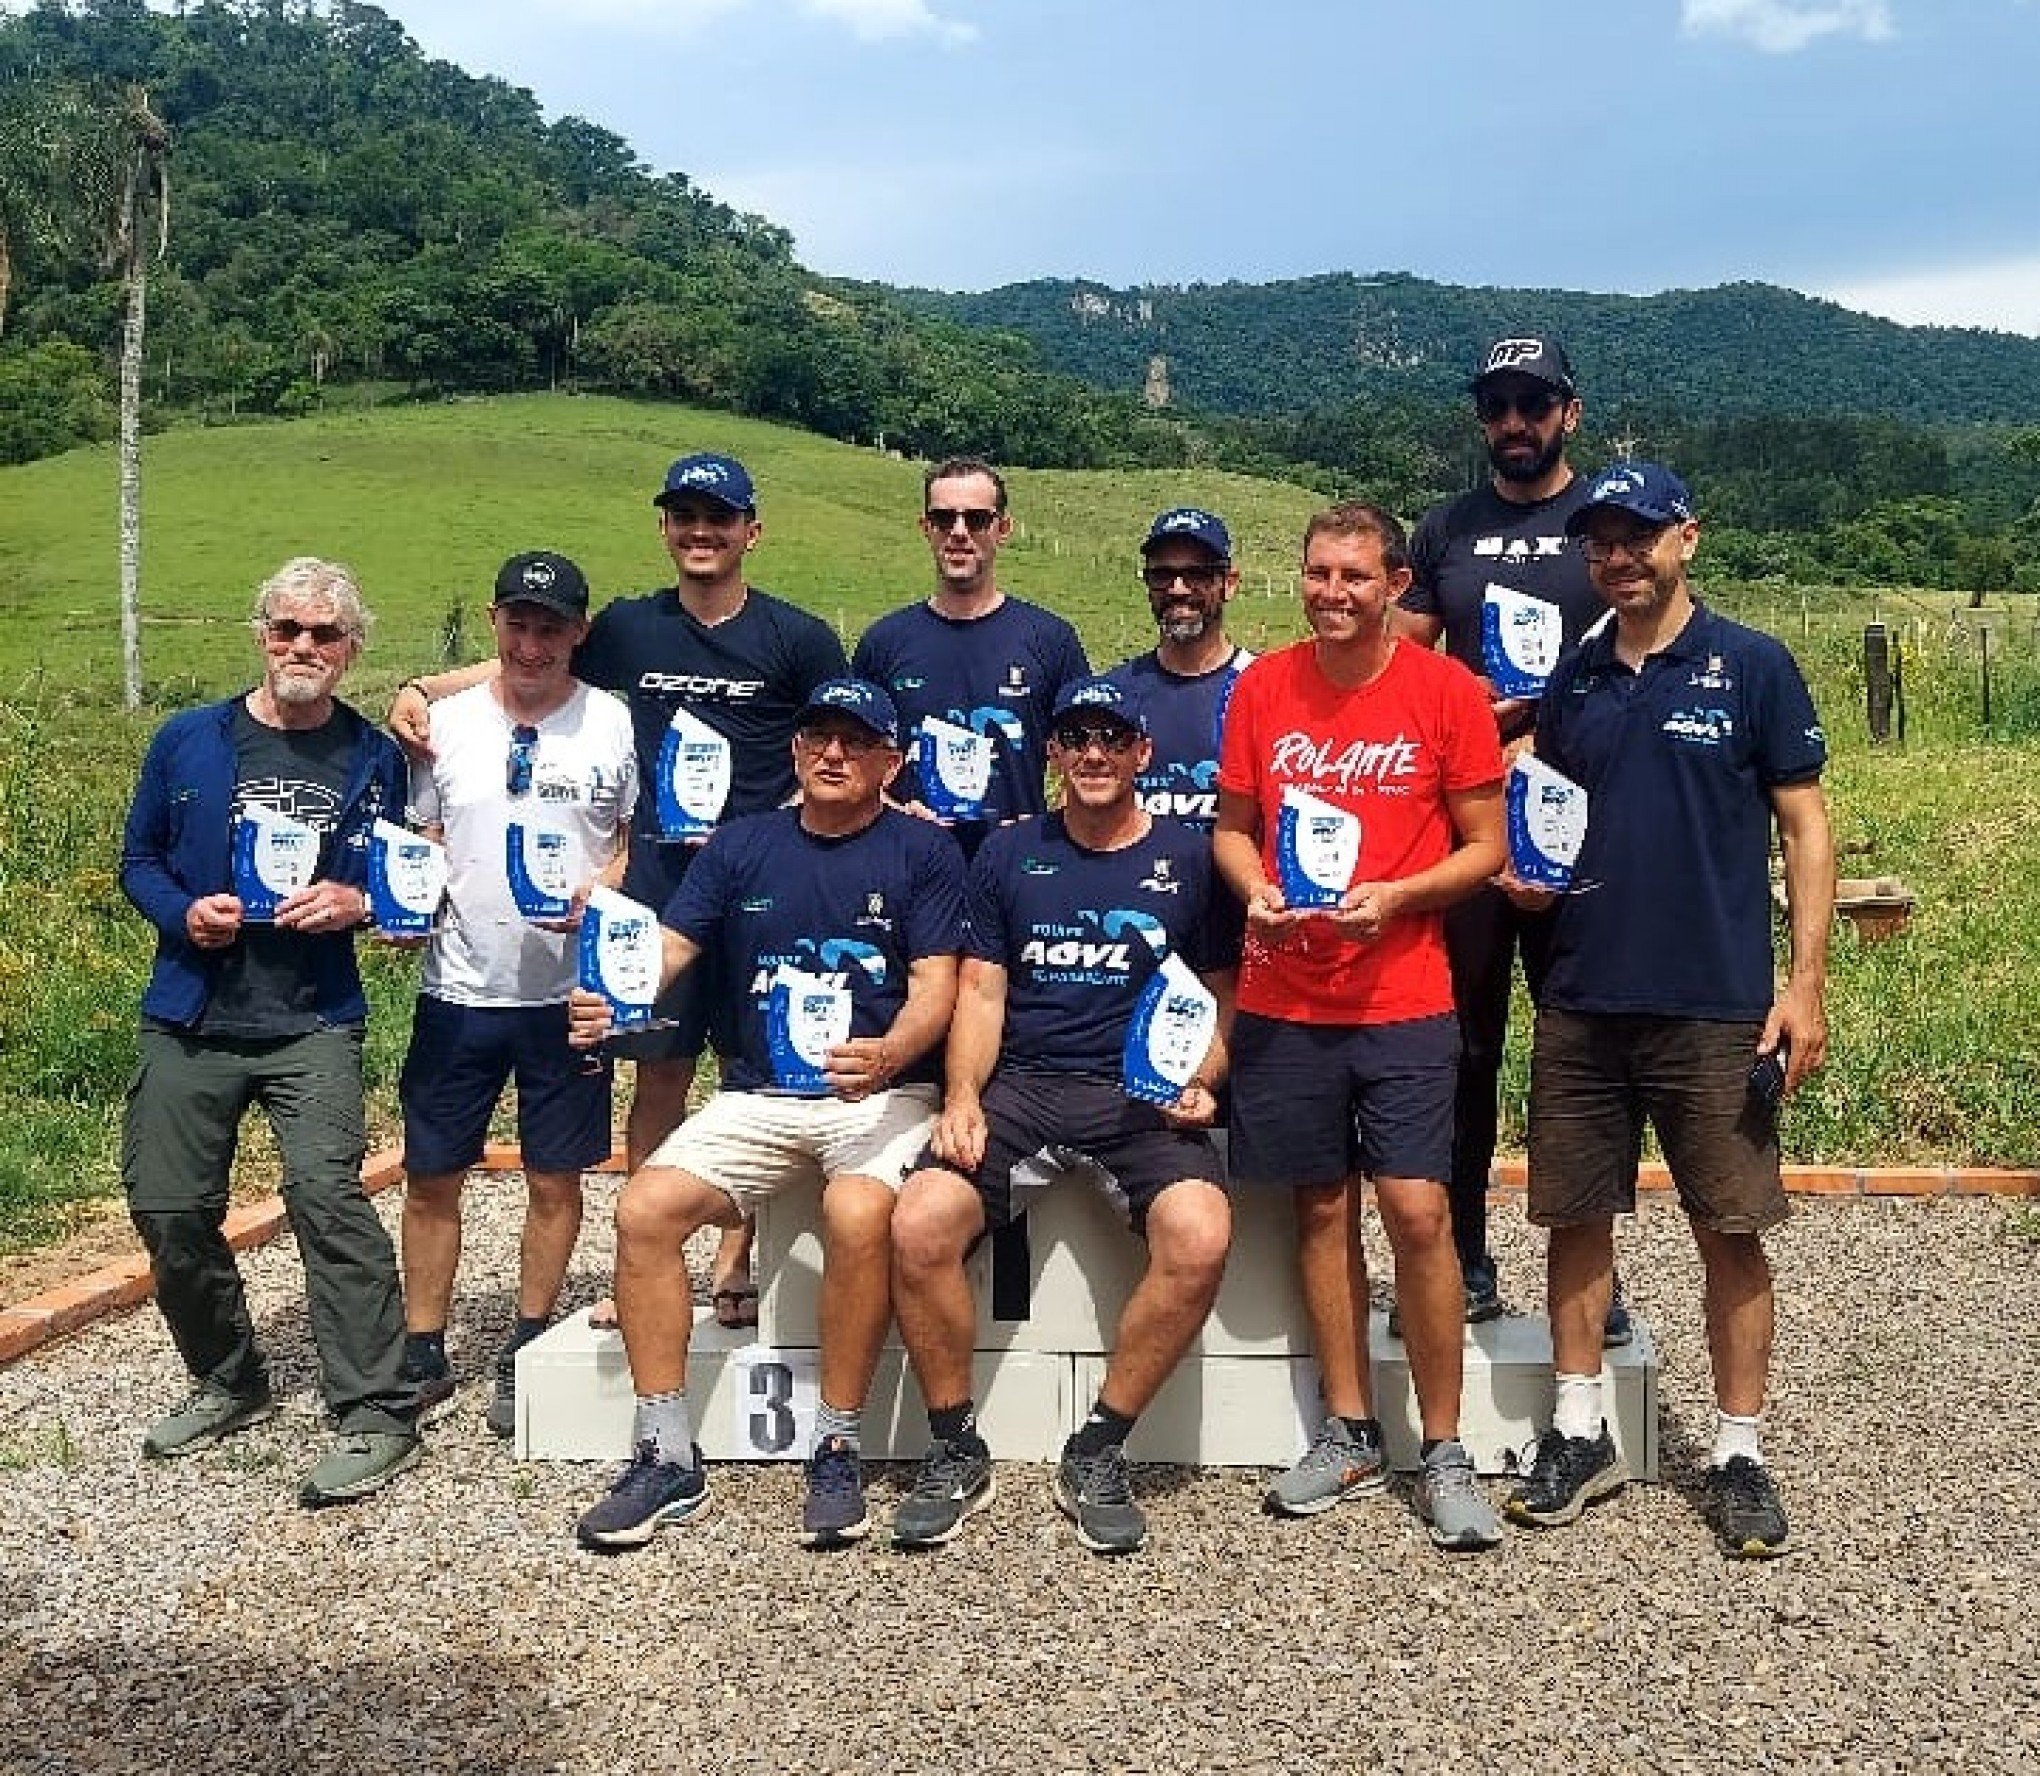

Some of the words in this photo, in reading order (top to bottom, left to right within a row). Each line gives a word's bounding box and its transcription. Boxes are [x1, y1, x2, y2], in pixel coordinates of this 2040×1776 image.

[1473, 537, 1563, 555] MAX
[639, 672, 765, 697] OZONE
[749, 1362, 796, 1454] 3
